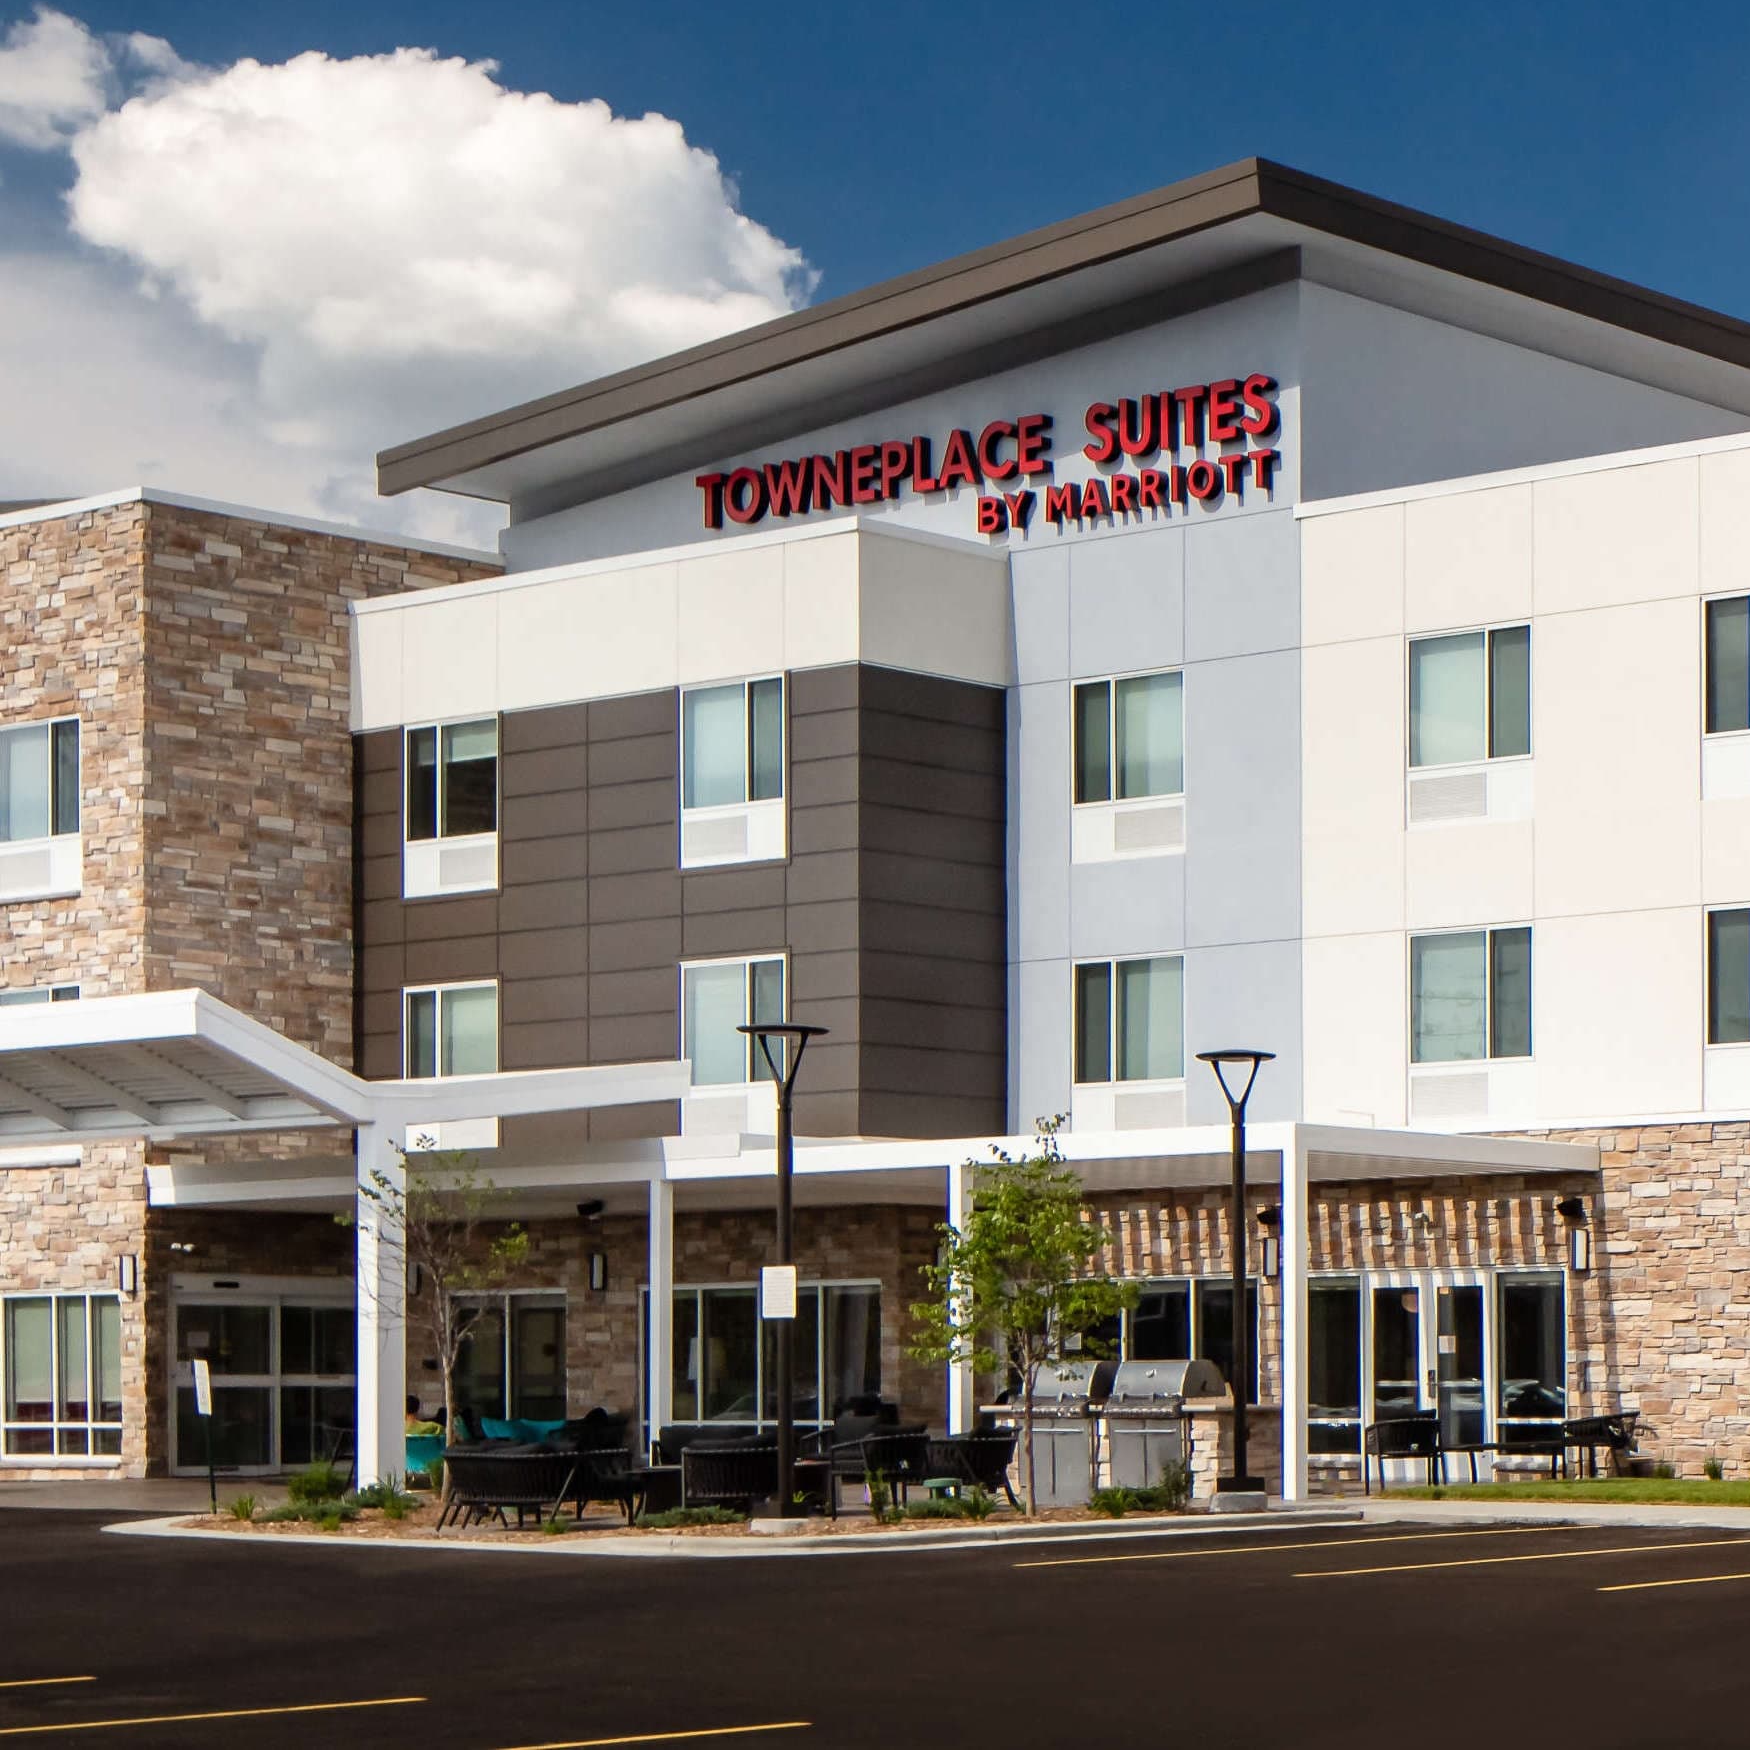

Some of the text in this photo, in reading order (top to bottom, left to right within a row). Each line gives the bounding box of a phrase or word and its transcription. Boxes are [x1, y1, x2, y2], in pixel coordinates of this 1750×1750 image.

[696, 373, 1278, 529] TOWNEPLACE SUITES
[977, 449, 1279, 534] BY MARRIOTT
